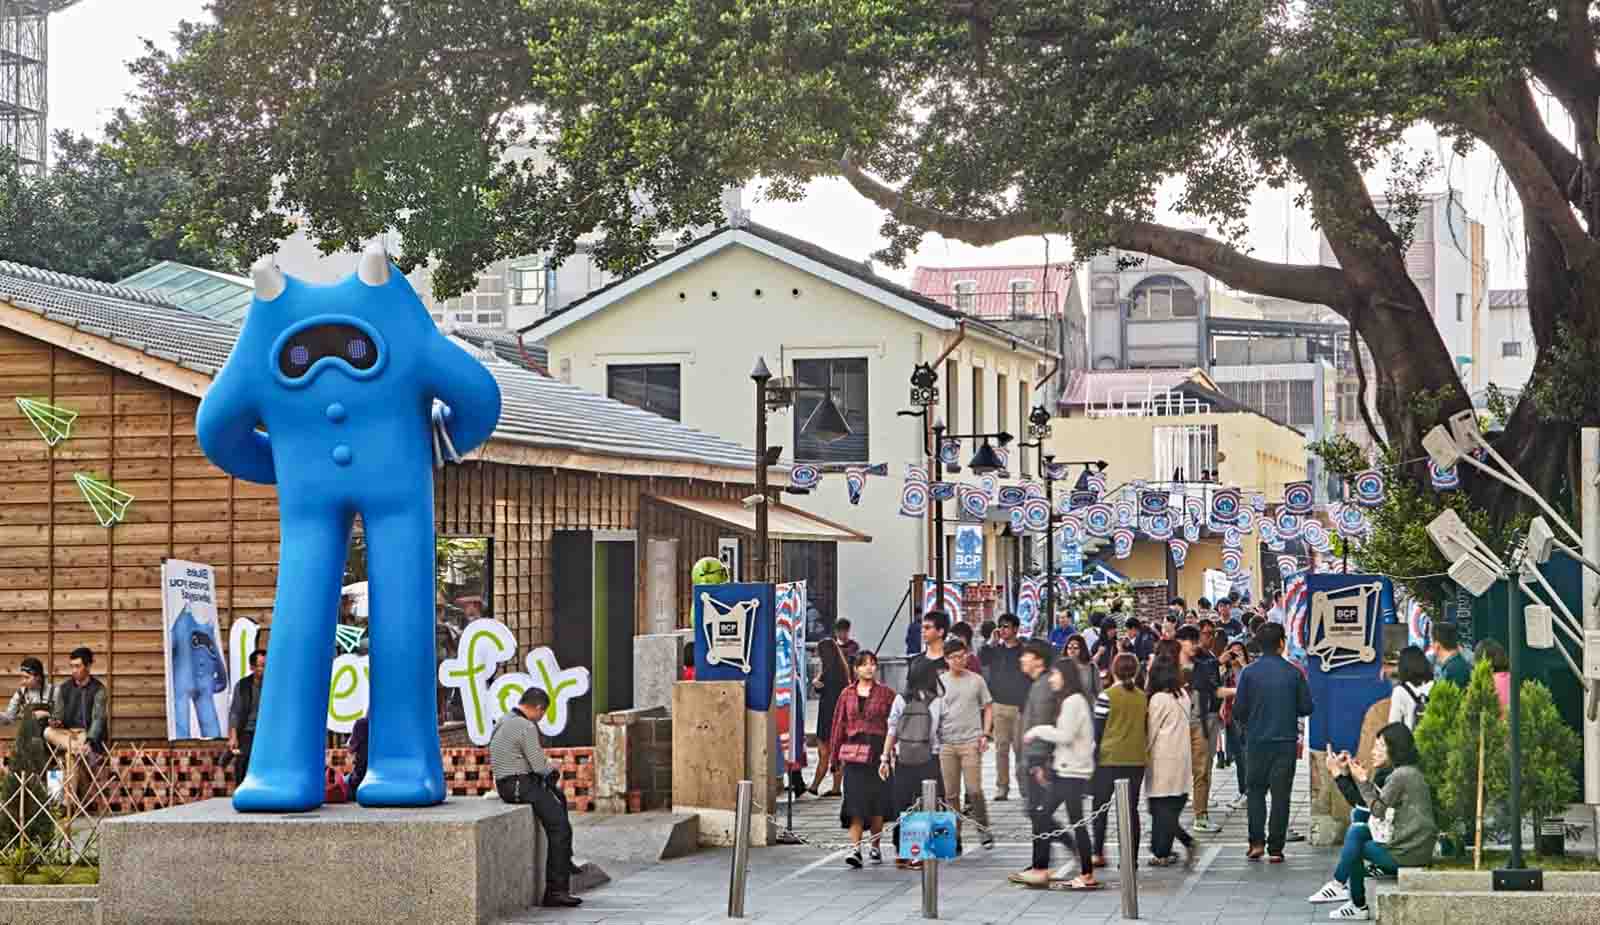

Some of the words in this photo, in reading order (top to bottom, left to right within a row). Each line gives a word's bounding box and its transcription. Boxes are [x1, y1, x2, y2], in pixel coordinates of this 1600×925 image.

[911, 388, 939, 401] BCP
[956, 554, 980, 565] BCP
[1336, 609, 1357, 618] BCP
[448, 629, 578, 736] for
